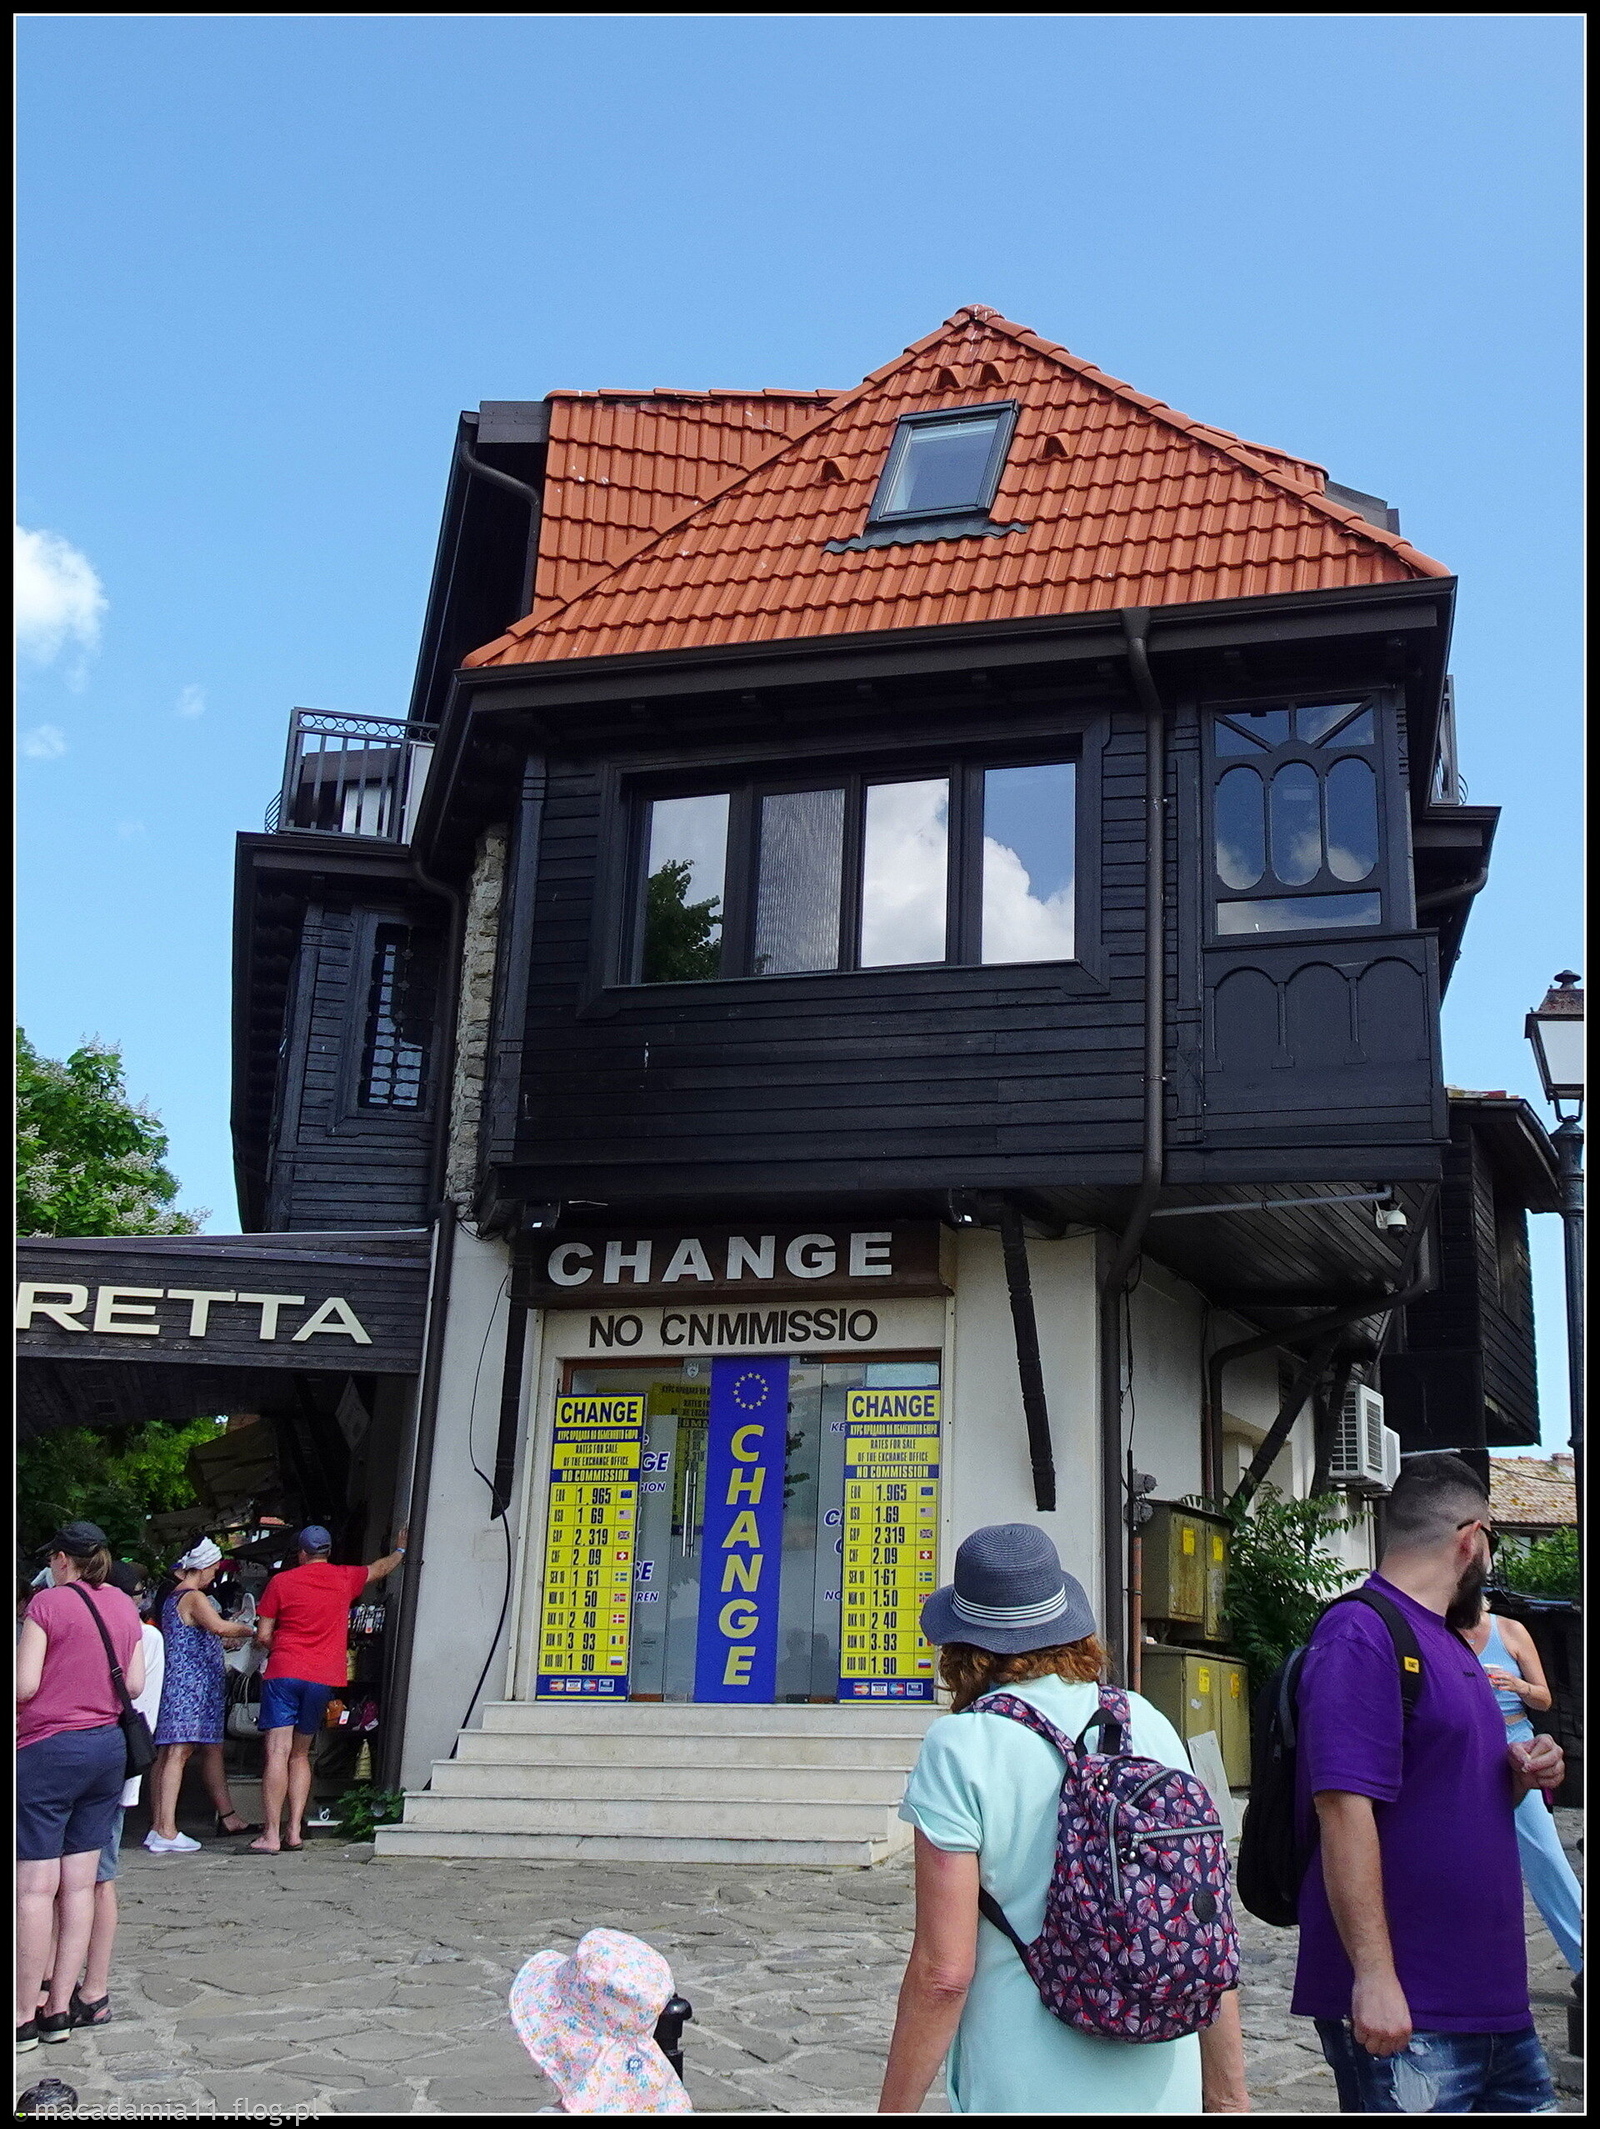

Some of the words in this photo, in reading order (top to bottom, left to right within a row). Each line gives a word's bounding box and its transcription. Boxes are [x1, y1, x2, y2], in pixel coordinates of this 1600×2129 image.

[547, 1231, 893, 1287] CHANGE
[16, 1282, 373, 1345] RETTA
[588, 1314, 643, 1348] NO
[660, 1308, 878, 1347] CNMMISSIO
[561, 1401, 638, 1423] CHANGE
[852, 1395, 935, 1417] CHANGE
[605, 1443, 618, 1453] SALE
[870, 1439, 888, 1449] RATES
[889, 1439, 901, 1449] FOR
[902, 1439, 916, 1449] SALE
[582, 1456, 609, 1466] EXCHANGE
[610, 1456, 629, 1465] OFFICE
[878, 1452, 907, 1462] EXCHANGE
[909, 1452, 928, 1461] OFFICE
[561, 1470, 573, 1482] NO
[574, 1469, 629, 1482] COMMISSION
[856, 1465, 868, 1478] NO
[870, 1465, 929, 1478] COMMISSION
[876, 1484, 907, 1501] 1.965
[875, 1505, 899, 1523] 1.69
[718, 1424, 766, 1686] CHANGE
[873, 1547, 898, 1565] 2.09
[873, 1589, 898, 1607] 1.50
[871, 1633, 897, 1651] 3.93
[871, 1656, 897, 1674] 1.90
